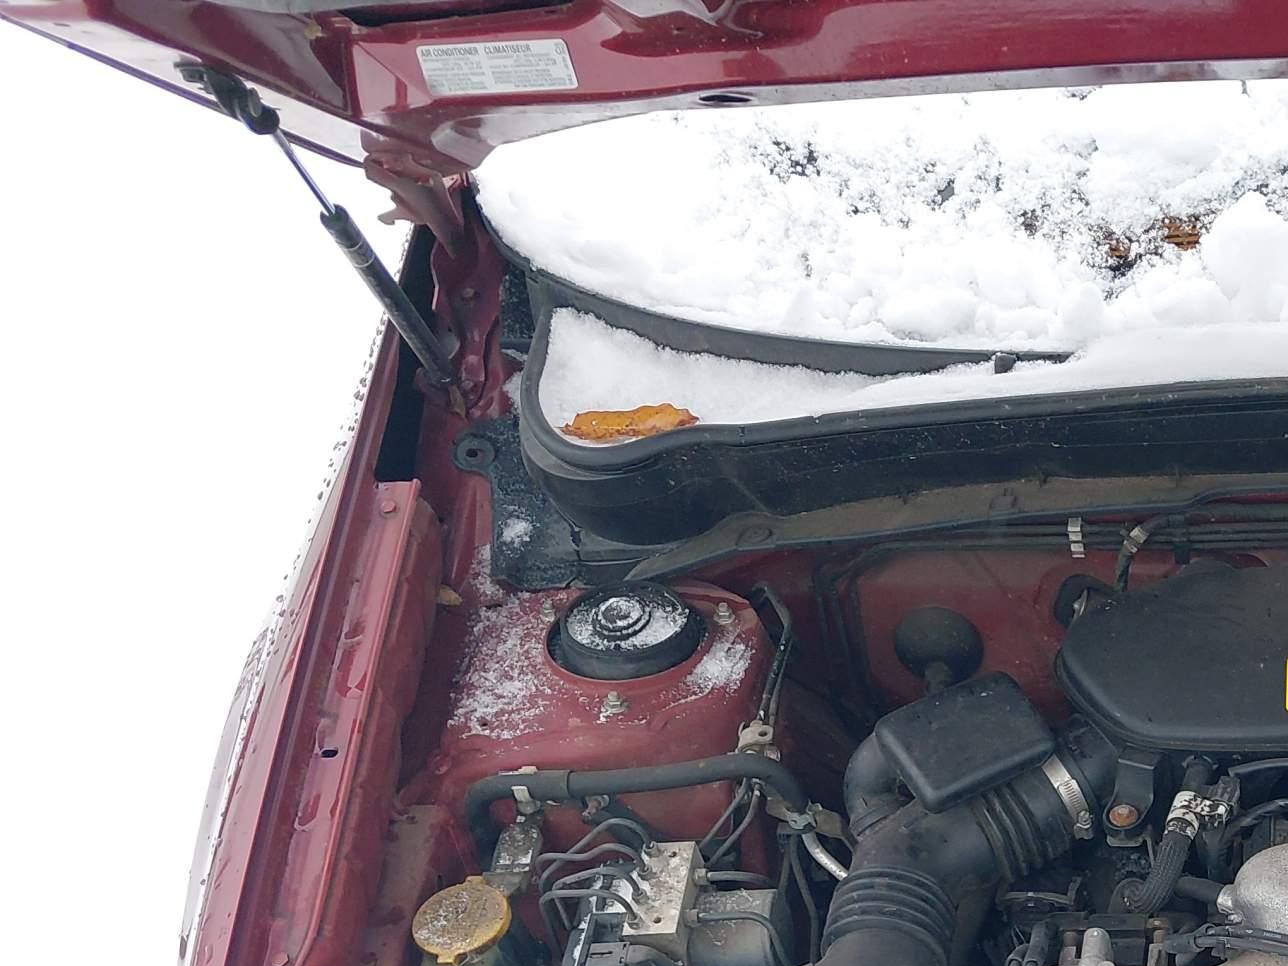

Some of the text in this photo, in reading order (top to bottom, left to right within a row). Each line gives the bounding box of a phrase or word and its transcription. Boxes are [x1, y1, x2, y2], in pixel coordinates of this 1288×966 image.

[421, 46, 479, 56] AIR CONDITIONER
[484, 44, 531, 54] CLIMATISEUR
